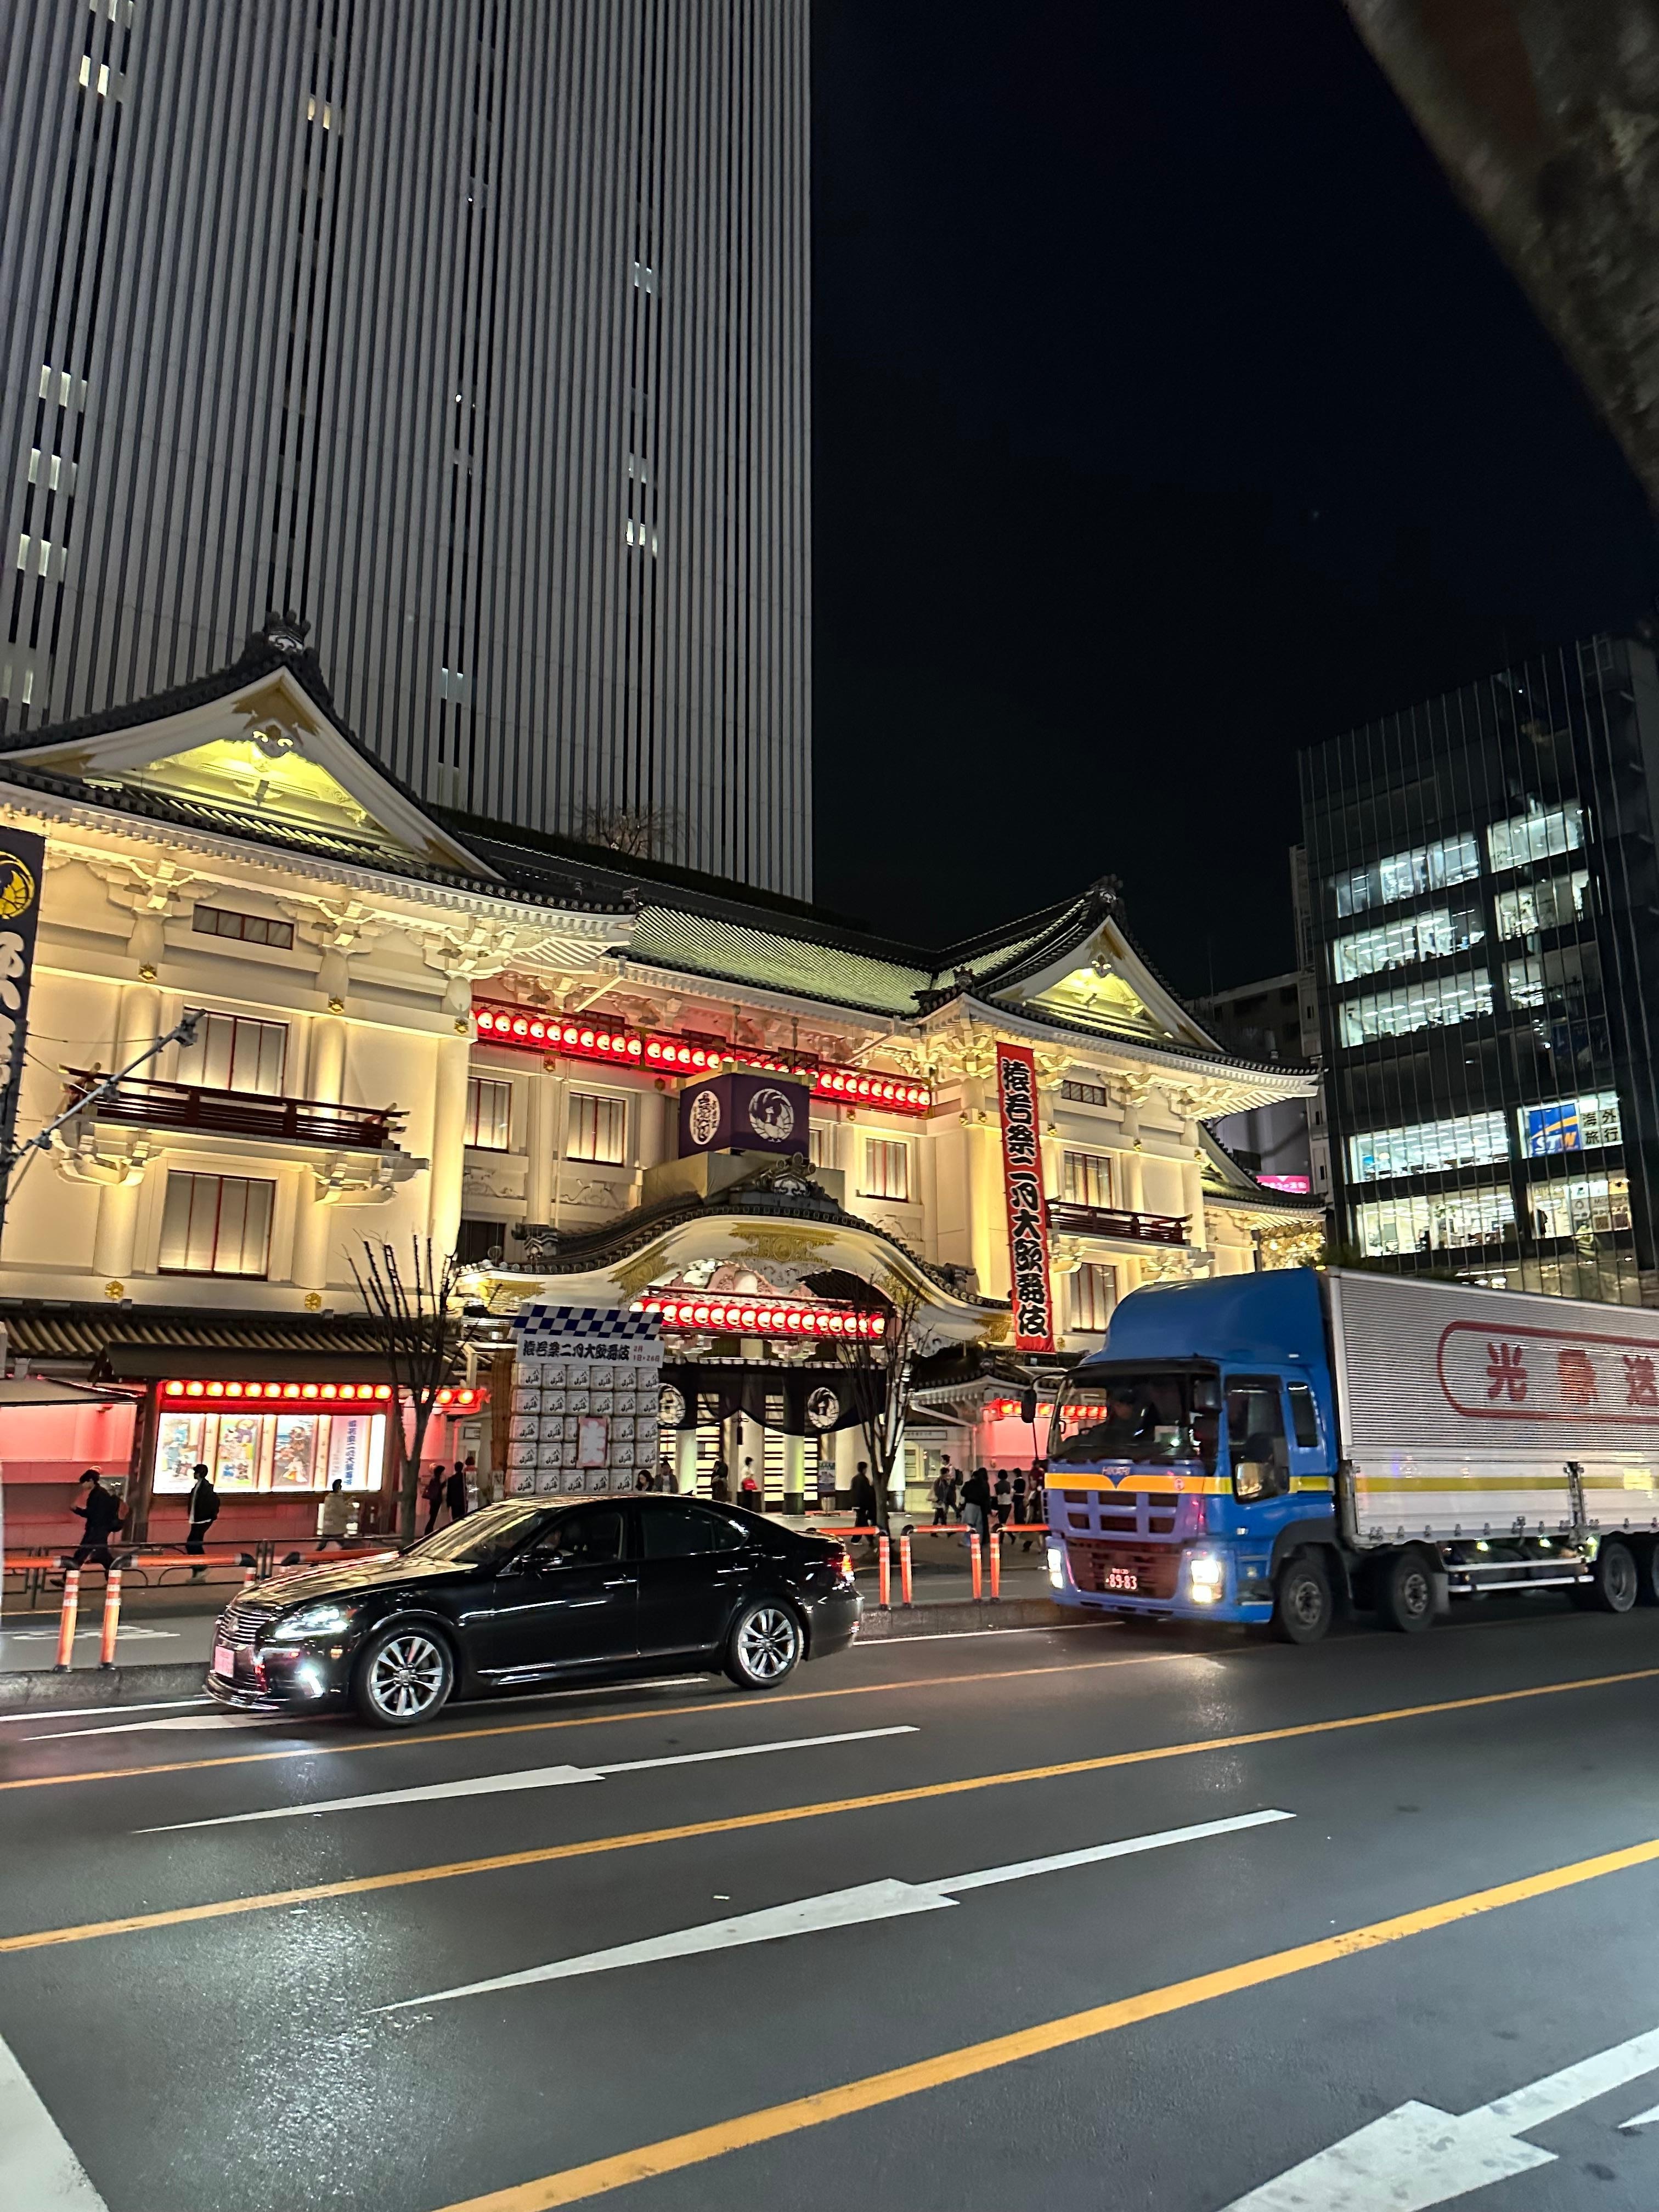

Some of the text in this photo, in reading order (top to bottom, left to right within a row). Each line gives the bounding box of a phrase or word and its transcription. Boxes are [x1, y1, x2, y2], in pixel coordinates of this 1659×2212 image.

[1583, 1108, 1617, 1127] 海外
[1535, 1131, 1577, 1153] STW
[1585, 1126, 1618, 1145] 旅行
